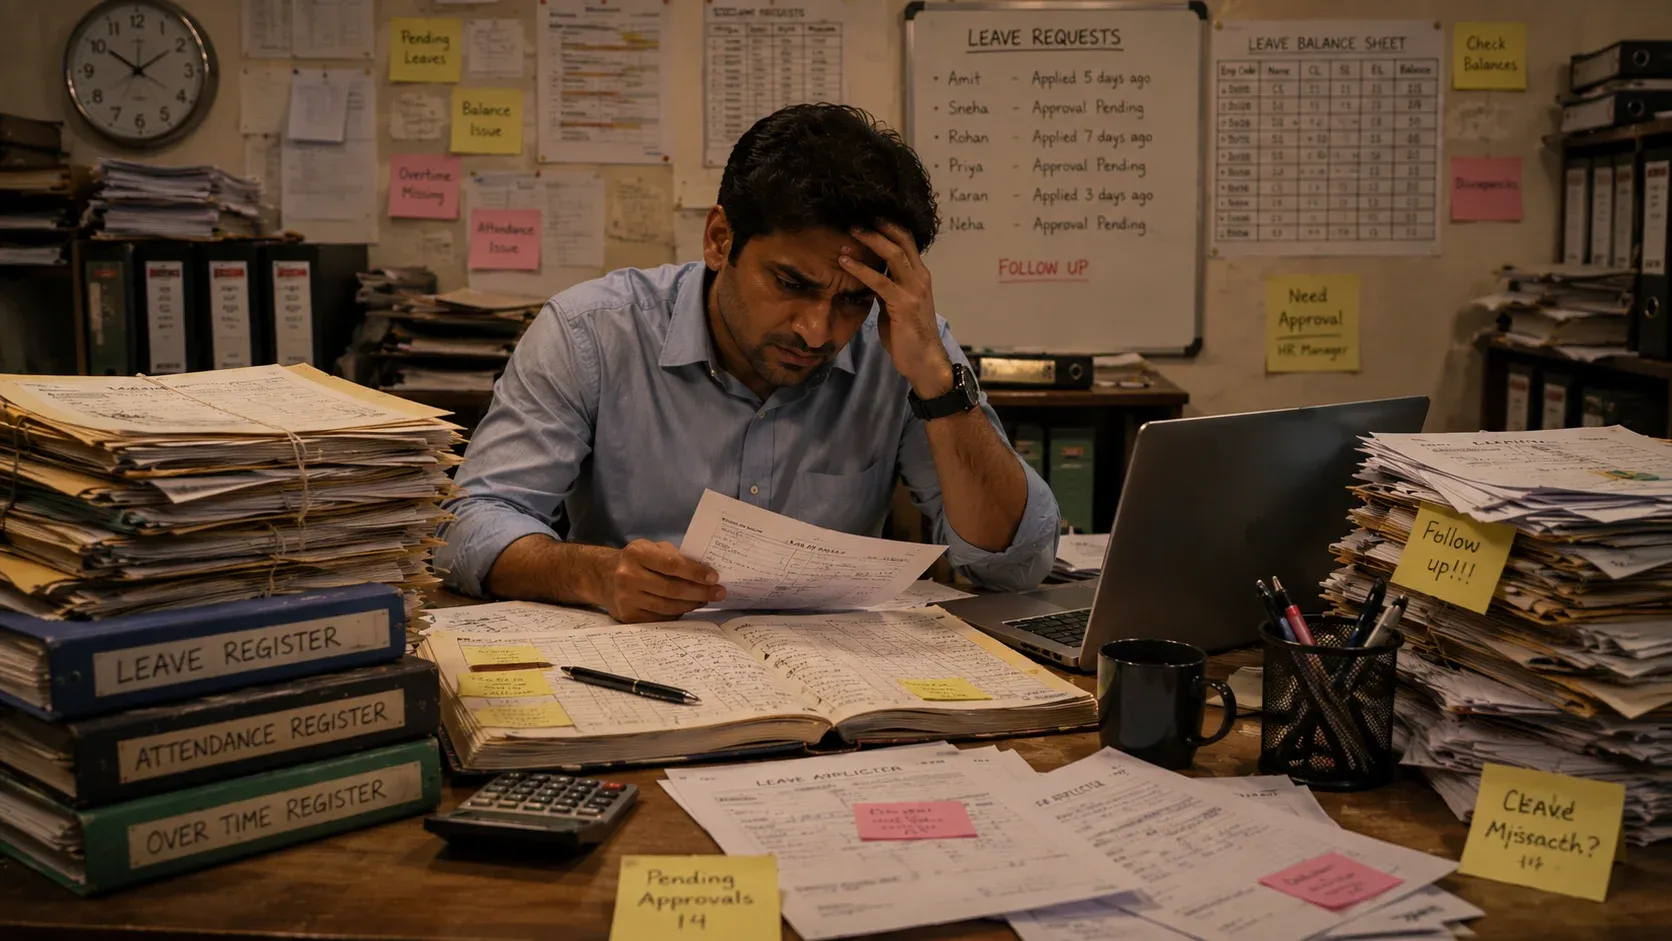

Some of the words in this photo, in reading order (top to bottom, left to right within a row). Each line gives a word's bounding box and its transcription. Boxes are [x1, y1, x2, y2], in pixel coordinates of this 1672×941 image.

[108, 22, 120, 36] 11
[130, 13, 146, 29] 12
[174, 37, 187, 53] 2
[401, 29, 450, 51] Pending
[968, 29, 1022, 47] LEAVE
[1032, 28, 1122, 46] REQUESTS
[1248, 36, 1290, 51] LEAVE
[1297, 36, 1357, 51] BALANCE
[1364, 35, 1407, 50] SHEET
[1466, 35, 1507, 52] Check
[90, 39, 107, 55] 10
[404, 50, 447, 65] Leaves
[1463, 57, 1518, 73] Balances
[82, 63, 95, 79] 9
[183, 63, 195, 79] 3
[948, 71, 982, 86] Amit
[1032, 71, 1076, 88] Applied
[1084, 71, 1093, 84] 5
[1097, 71, 1125, 88] days
[1130, 73, 1151, 87] ago
[91, 89, 103, 104] 8
[175, 89, 187, 104] 4
[109, 106, 122, 122] 7
[159, 106, 171, 122] 5
[462, 101, 511, 117] Balance
[948, 101, 990, 115] Sneha
[1032, 101, 1086, 117] Approval
[1096, 101, 1144, 119] Pending
[134, 113, 146, 128] 6
[470, 122, 502, 137] Issue
[948, 131, 990, 144] Rohan
[1032, 131, 1077, 147] Applied
[1084, 131, 1094, 143] 7
[1097, 131, 1125, 148] days
[1130, 133, 1153, 146] ago
[398, 166, 453, 182] Overtime
[949, 160, 984, 178] Priya
[1033, 160, 1088, 177] Approval
[1097, 160, 1146, 177] Pending
[401, 186, 445, 207] Missing
[949, 190, 989, 202] Karan
[1033, 190, 1078, 206] Applied
[1085, 190, 1094, 202] 3
[1098, 190, 1126, 206] days
[1131, 192, 1154, 206] ago
[950, 219, 985, 231] Neha
[1033, 219, 1088, 235] Approval
[1097, 219, 1146, 236] Pending
[489, 241, 519, 254] Issue
[998, 259, 1059, 276] FOLLOW
[1066, 259, 1090, 276] UP
[1289, 288, 1328, 304] Need
[1278, 311, 1344, 334] Approval
[1277, 343, 1296, 358] HR
[1300, 343, 1348, 361] Manager
[1422, 519, 1481, 554] Follow
[1426, 557, 1477, 586] up!!!
[117, 646, 204, 685] LEAVE
[223, 625, 342, 666] REGISTER
[135, 722, 276, 771] ATTENDANCE
[291, 700, 389, 740] REGISTER
[146, 819, 210, 856] OVER
[219, 803, 272, 836] TIME
[286, 778, 388, 822] REGISTER
[646, 868, 737, 891] Pending
[638, 890, 756, 912] Approvals
[676, 913, 708, 931] 14
